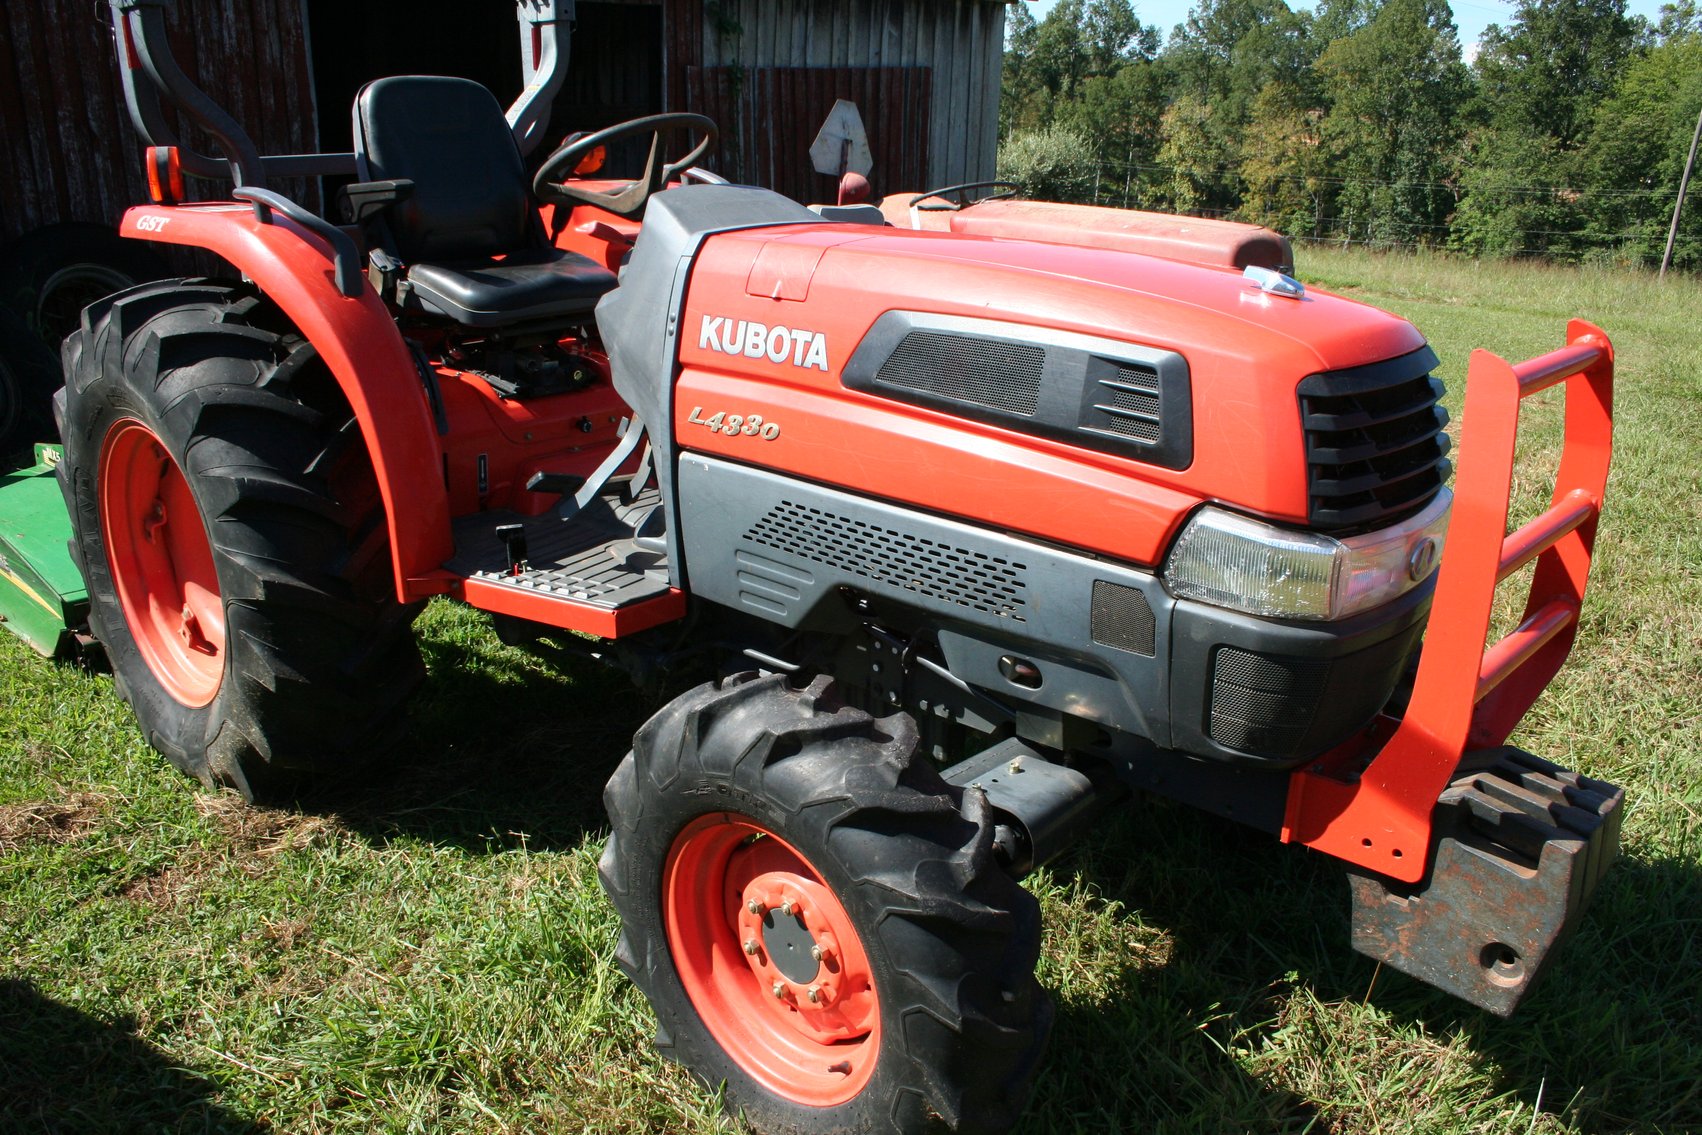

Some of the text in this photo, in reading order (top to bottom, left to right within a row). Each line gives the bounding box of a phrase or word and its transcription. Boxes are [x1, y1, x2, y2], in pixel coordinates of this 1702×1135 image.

[136, 215, 170, 232] GST
[698, 314, 829, 371] KUBOTA
[688, 406, 781, 441] L4330
